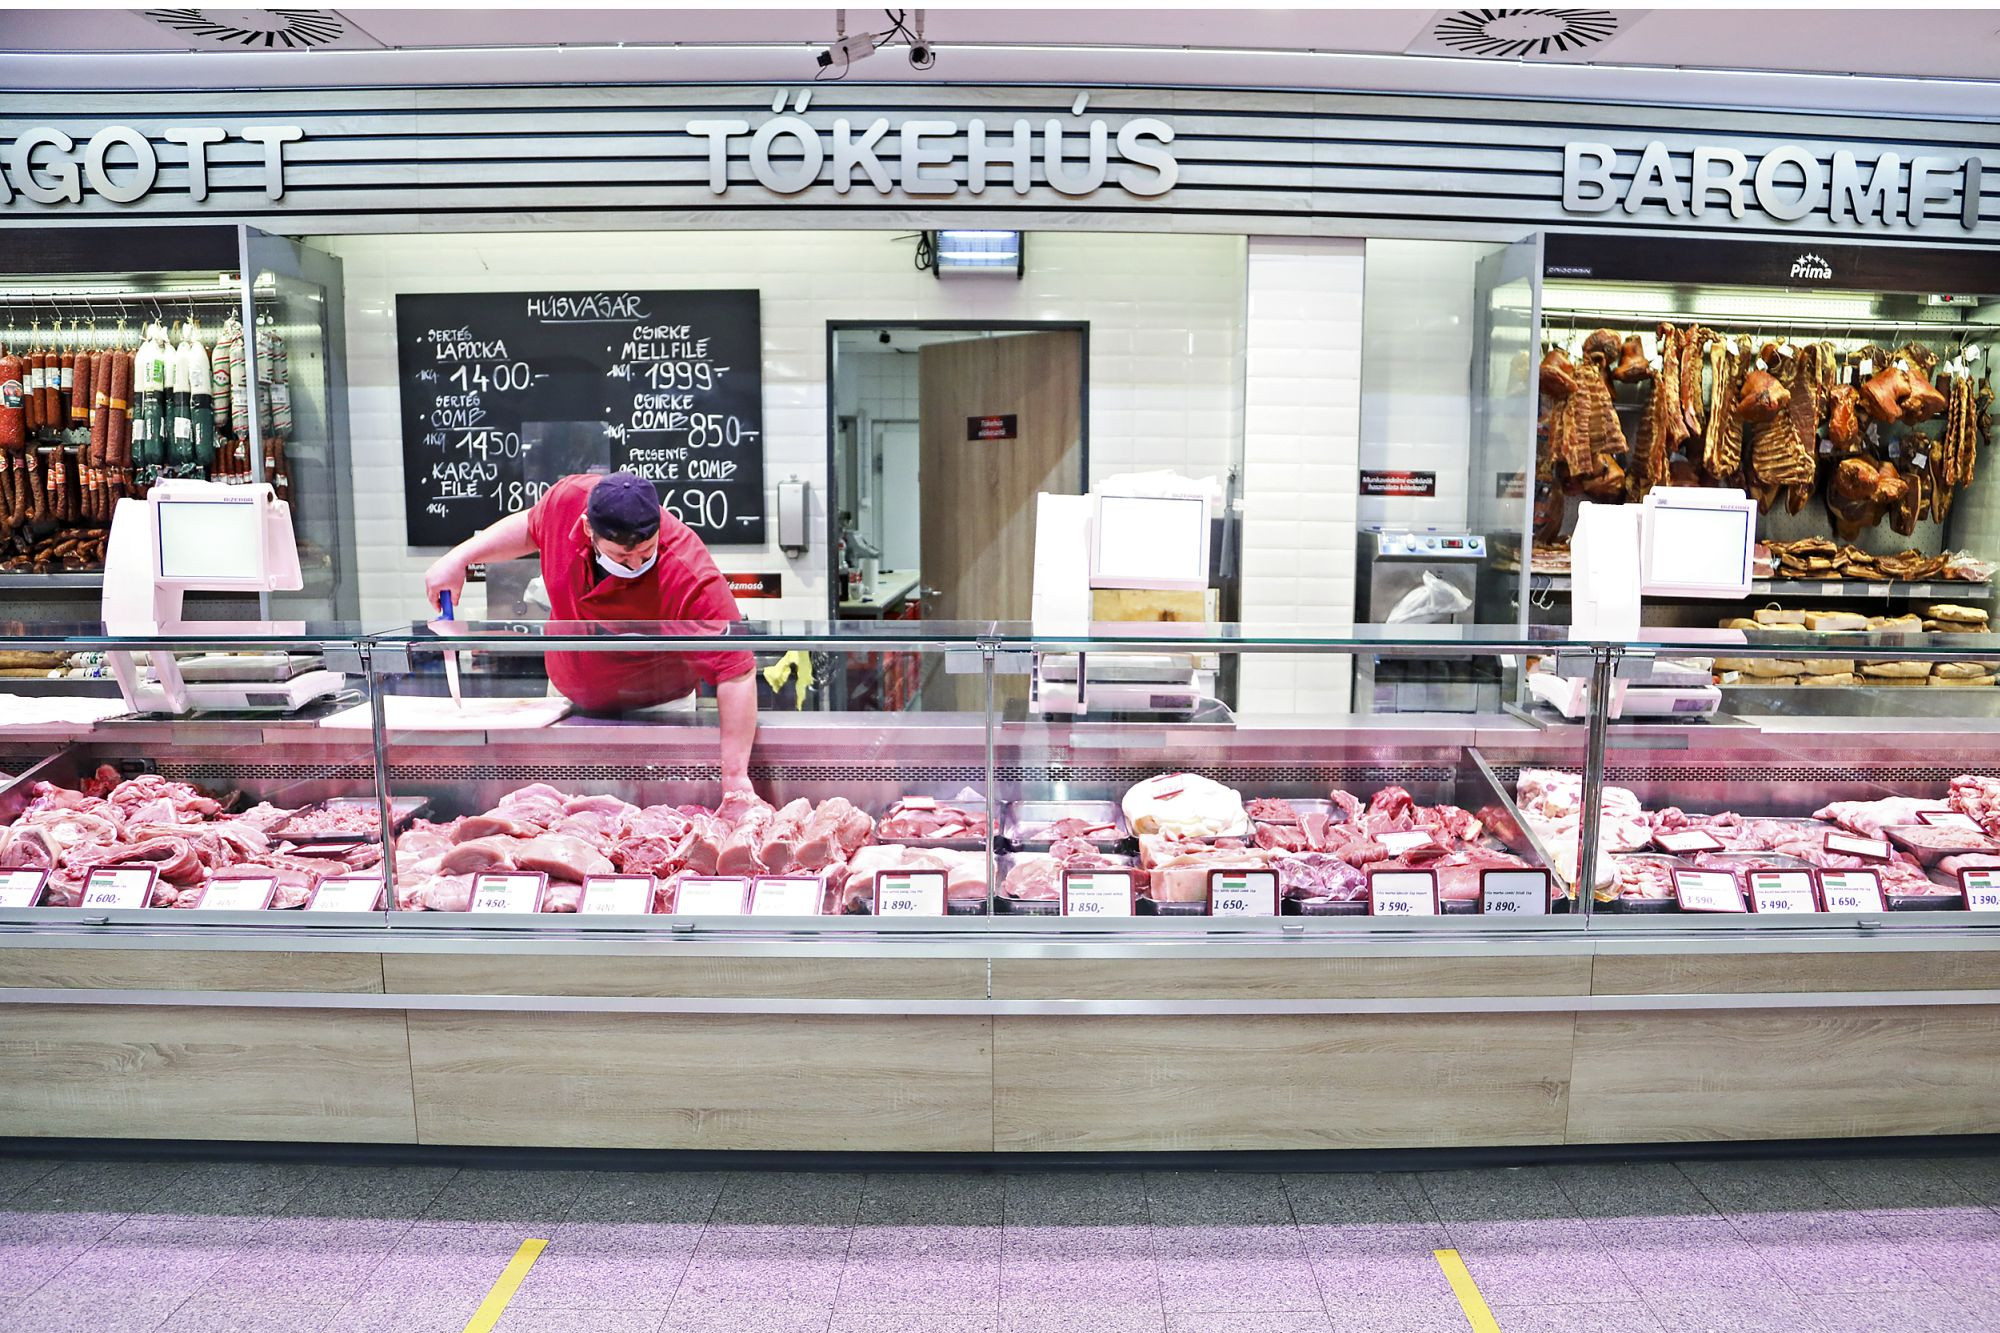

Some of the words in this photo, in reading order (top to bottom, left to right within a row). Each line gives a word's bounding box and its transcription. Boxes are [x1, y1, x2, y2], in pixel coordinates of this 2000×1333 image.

[686, 88, 1179, 196] TŐKEHÚS
[1562, 140, 1982, 230] BAROMFI
[527, 292, 652, 319] HÚSVÁSÁR
[428, 325, 472, 343] SERTÉS
[633, 325, 691, 341] CSIRKE
[436, 340, 509, 361] LAPOCKA
[621, 337, 712, 361] MELLFILÉ
[436, 390, 480, 408] SERTÉS
[633, 393, 694, 410] CSIRKE
[431, 407, 486, 427] COMB
[632, 411, 689, 430] COMB
[629, 447, 688, 461] PECSENYE
[432, 462, 498, 481] KARAJ
[688, 460, 737, 479] COMB
[440, 480, 478, 496] FILÉ
[727, 581, 764, 590] ézmosó
[881, 900, 888, 910] 1
[891, 900, 918, 911] 890,-
[1068, 902, 1075, 912] 1
[1078, 902, 1105, 914] 850,-
[1213, 899, 1220, 910] 1
[1222, 899, 1249, 911] 650,-
[1378, 901, 1386, 912] 3
[1387, 901, 1413, 913] 590,-
[1485, 901, 1493, 911] 3
[1494, 901, 1521, 913] 890,-
[1761, 900, 1767, 910] 5
[1769, 900, 1794, 911] 490,-
[1830, 896, 1836, 906] 1
[1838, 896, 1862, 908] 650,-
[1972, 895, 1977, 905] 1
[1979, 895, 2000, 906] 390,
